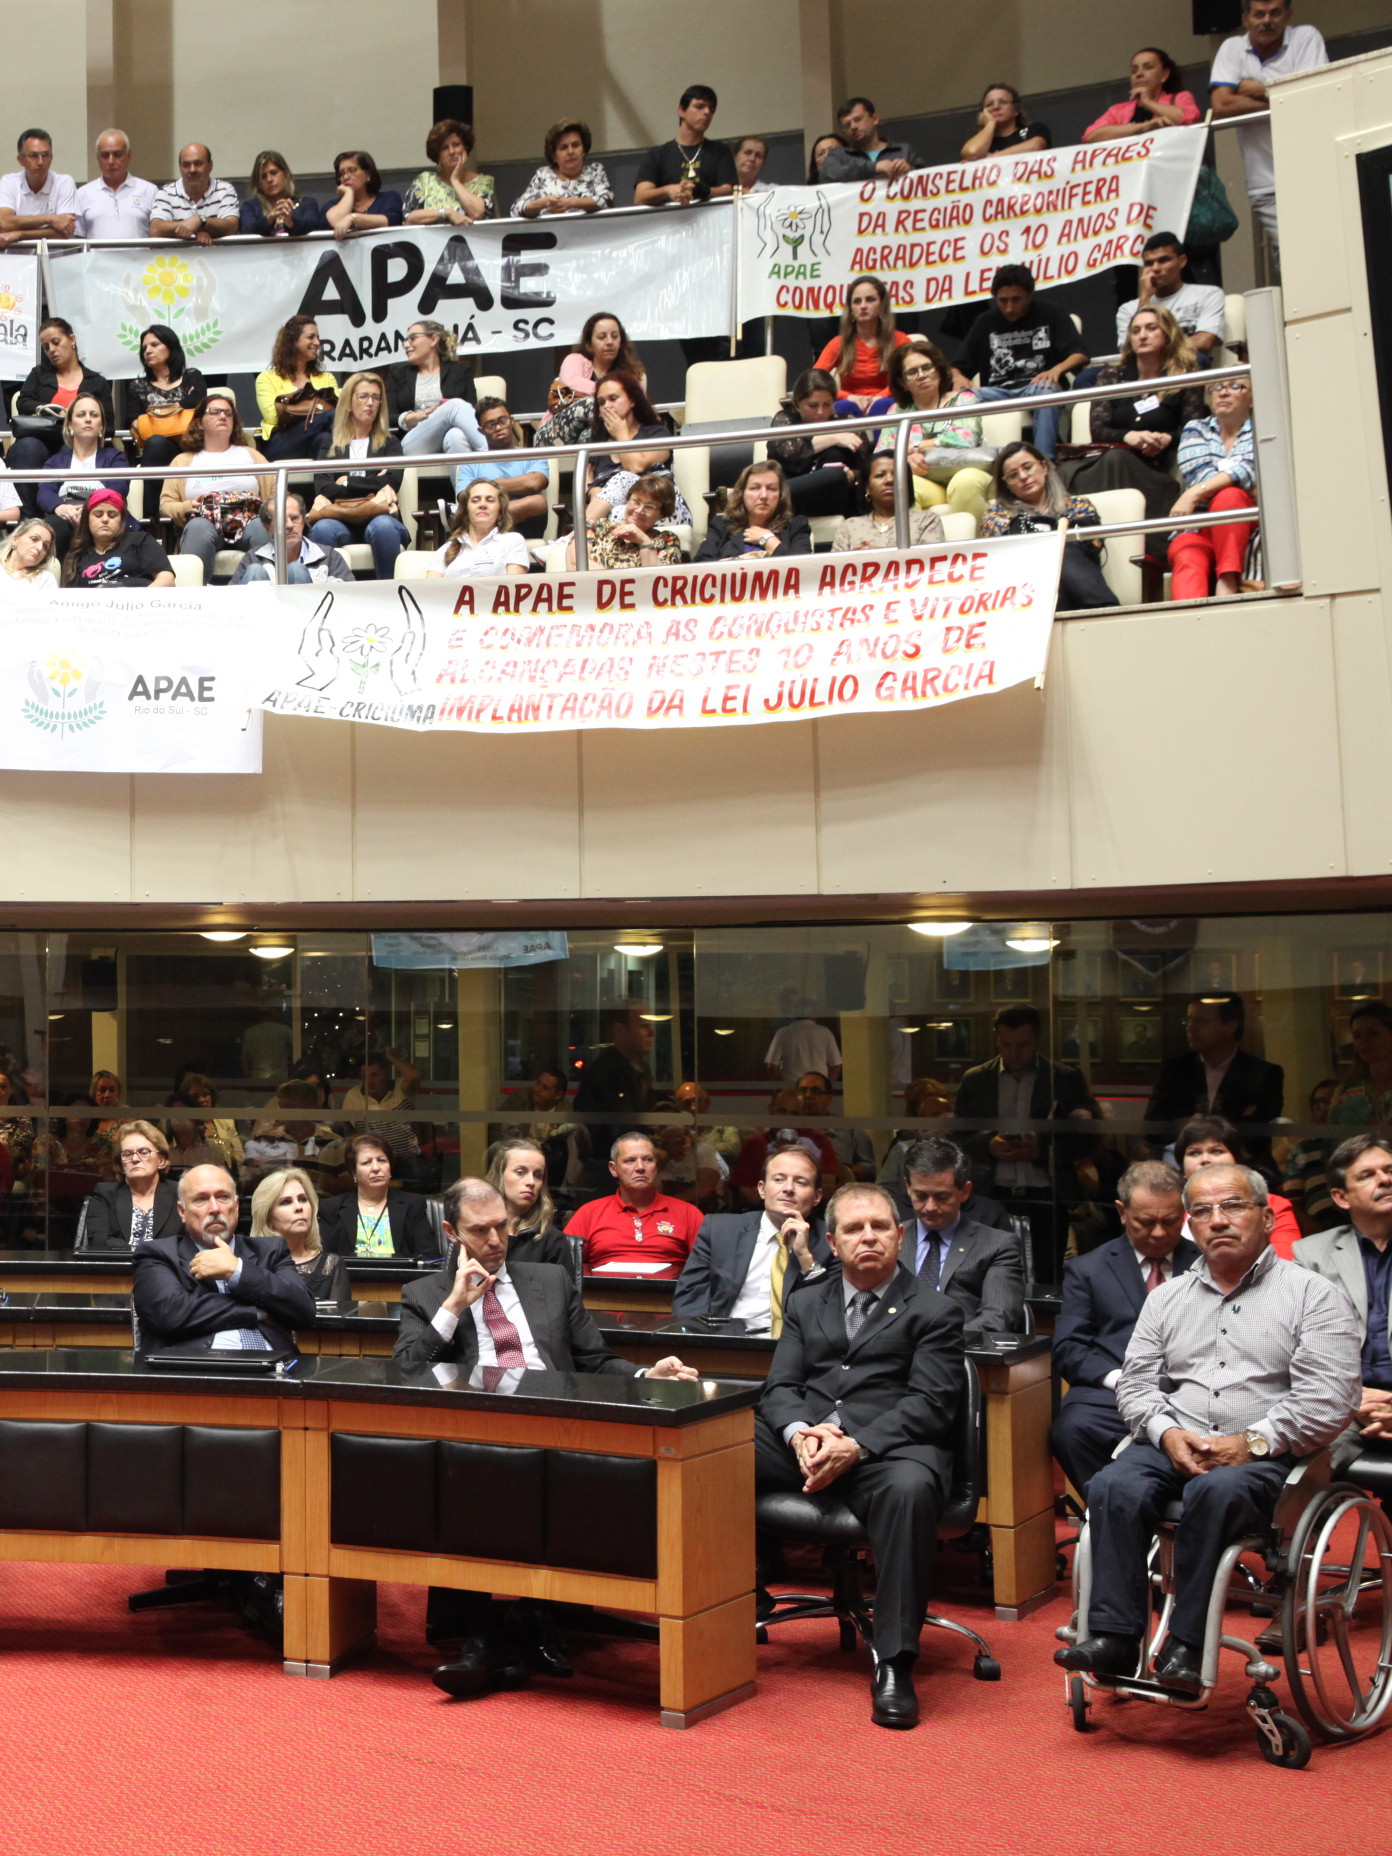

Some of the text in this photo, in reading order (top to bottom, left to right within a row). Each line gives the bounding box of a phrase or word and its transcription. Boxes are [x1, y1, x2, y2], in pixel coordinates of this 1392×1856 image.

[859, 137, 1155, 203] O CONSELHO DAS APAES
[850, 201, 1158, 273] AGRADECE OS 10 ANOS DE
[856, 175, 1120, 238] DA REGIÃO CARBONÍFERA
[296, 232, 559, 328] APAE
[768, 261, 822, 280] APAE
[925, 274, 953, 303] DA
[513, 317, 556, 342] SC
[49, 599, 100, 609] Amigo
[150, 599, 202, 611] Garcia
[453, 552, 988, 616] A APAE DE CRICIÚMA AGRADECE
[448, 582, 1037, 650] E COMEMORA AS CONQUISTAS E VITÓRIAS
[435, 621, 987, 690] ALCANÇADAS NESTES 10 ANOS DE
[127, 674, 216, 703] APAE
[134, 706, 150, 715] Rio
[153, 706, 165, 715] do
[168, 706, 184, 715] Sul
[193, 706, 208, 716] SC
[437, 660, 996, 724] IMPLANTAÇÃO DA LEI JÚLIO GARCIA
